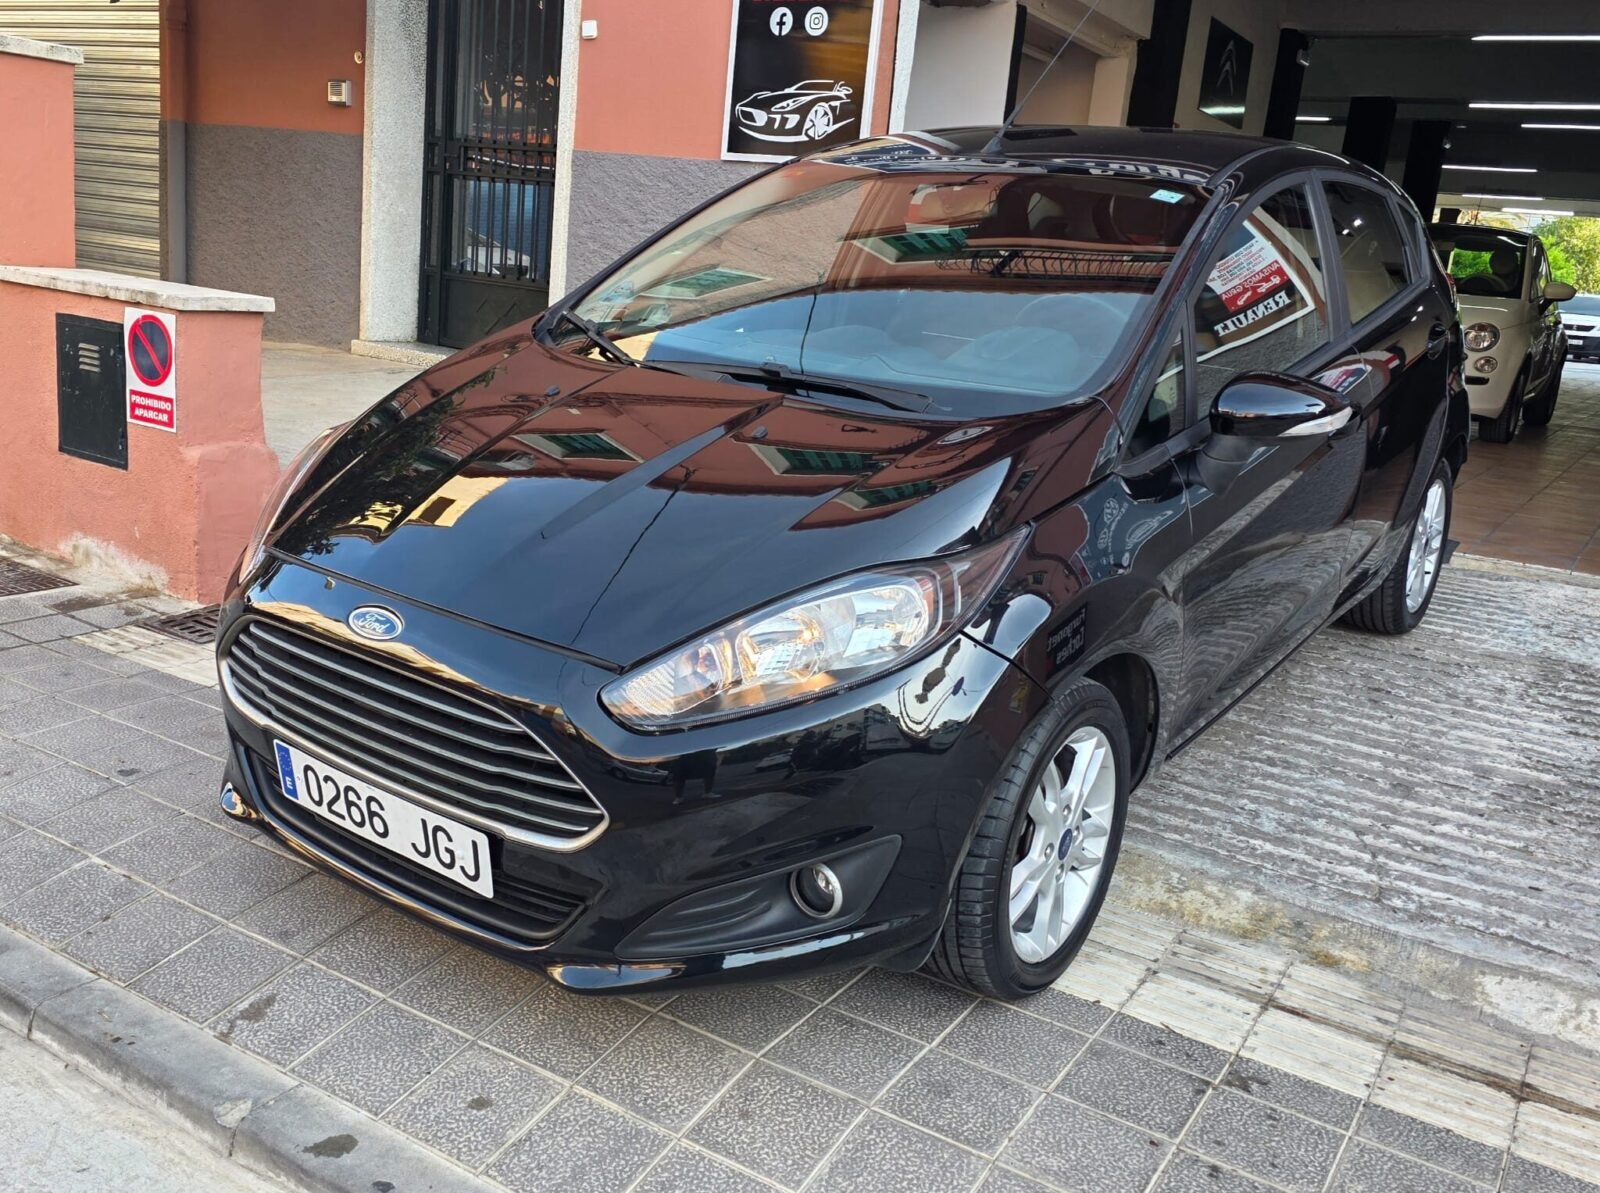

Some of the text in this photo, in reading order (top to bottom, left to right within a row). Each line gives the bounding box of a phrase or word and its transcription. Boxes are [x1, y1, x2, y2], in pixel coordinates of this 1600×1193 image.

[131, 394, 172, 411] PROHIBIDO
[134, 407, 169, 422] APARCAR
[358, 612, 391, 633] Ford
[285, 764, 481, 882] E 0266 JGJ
